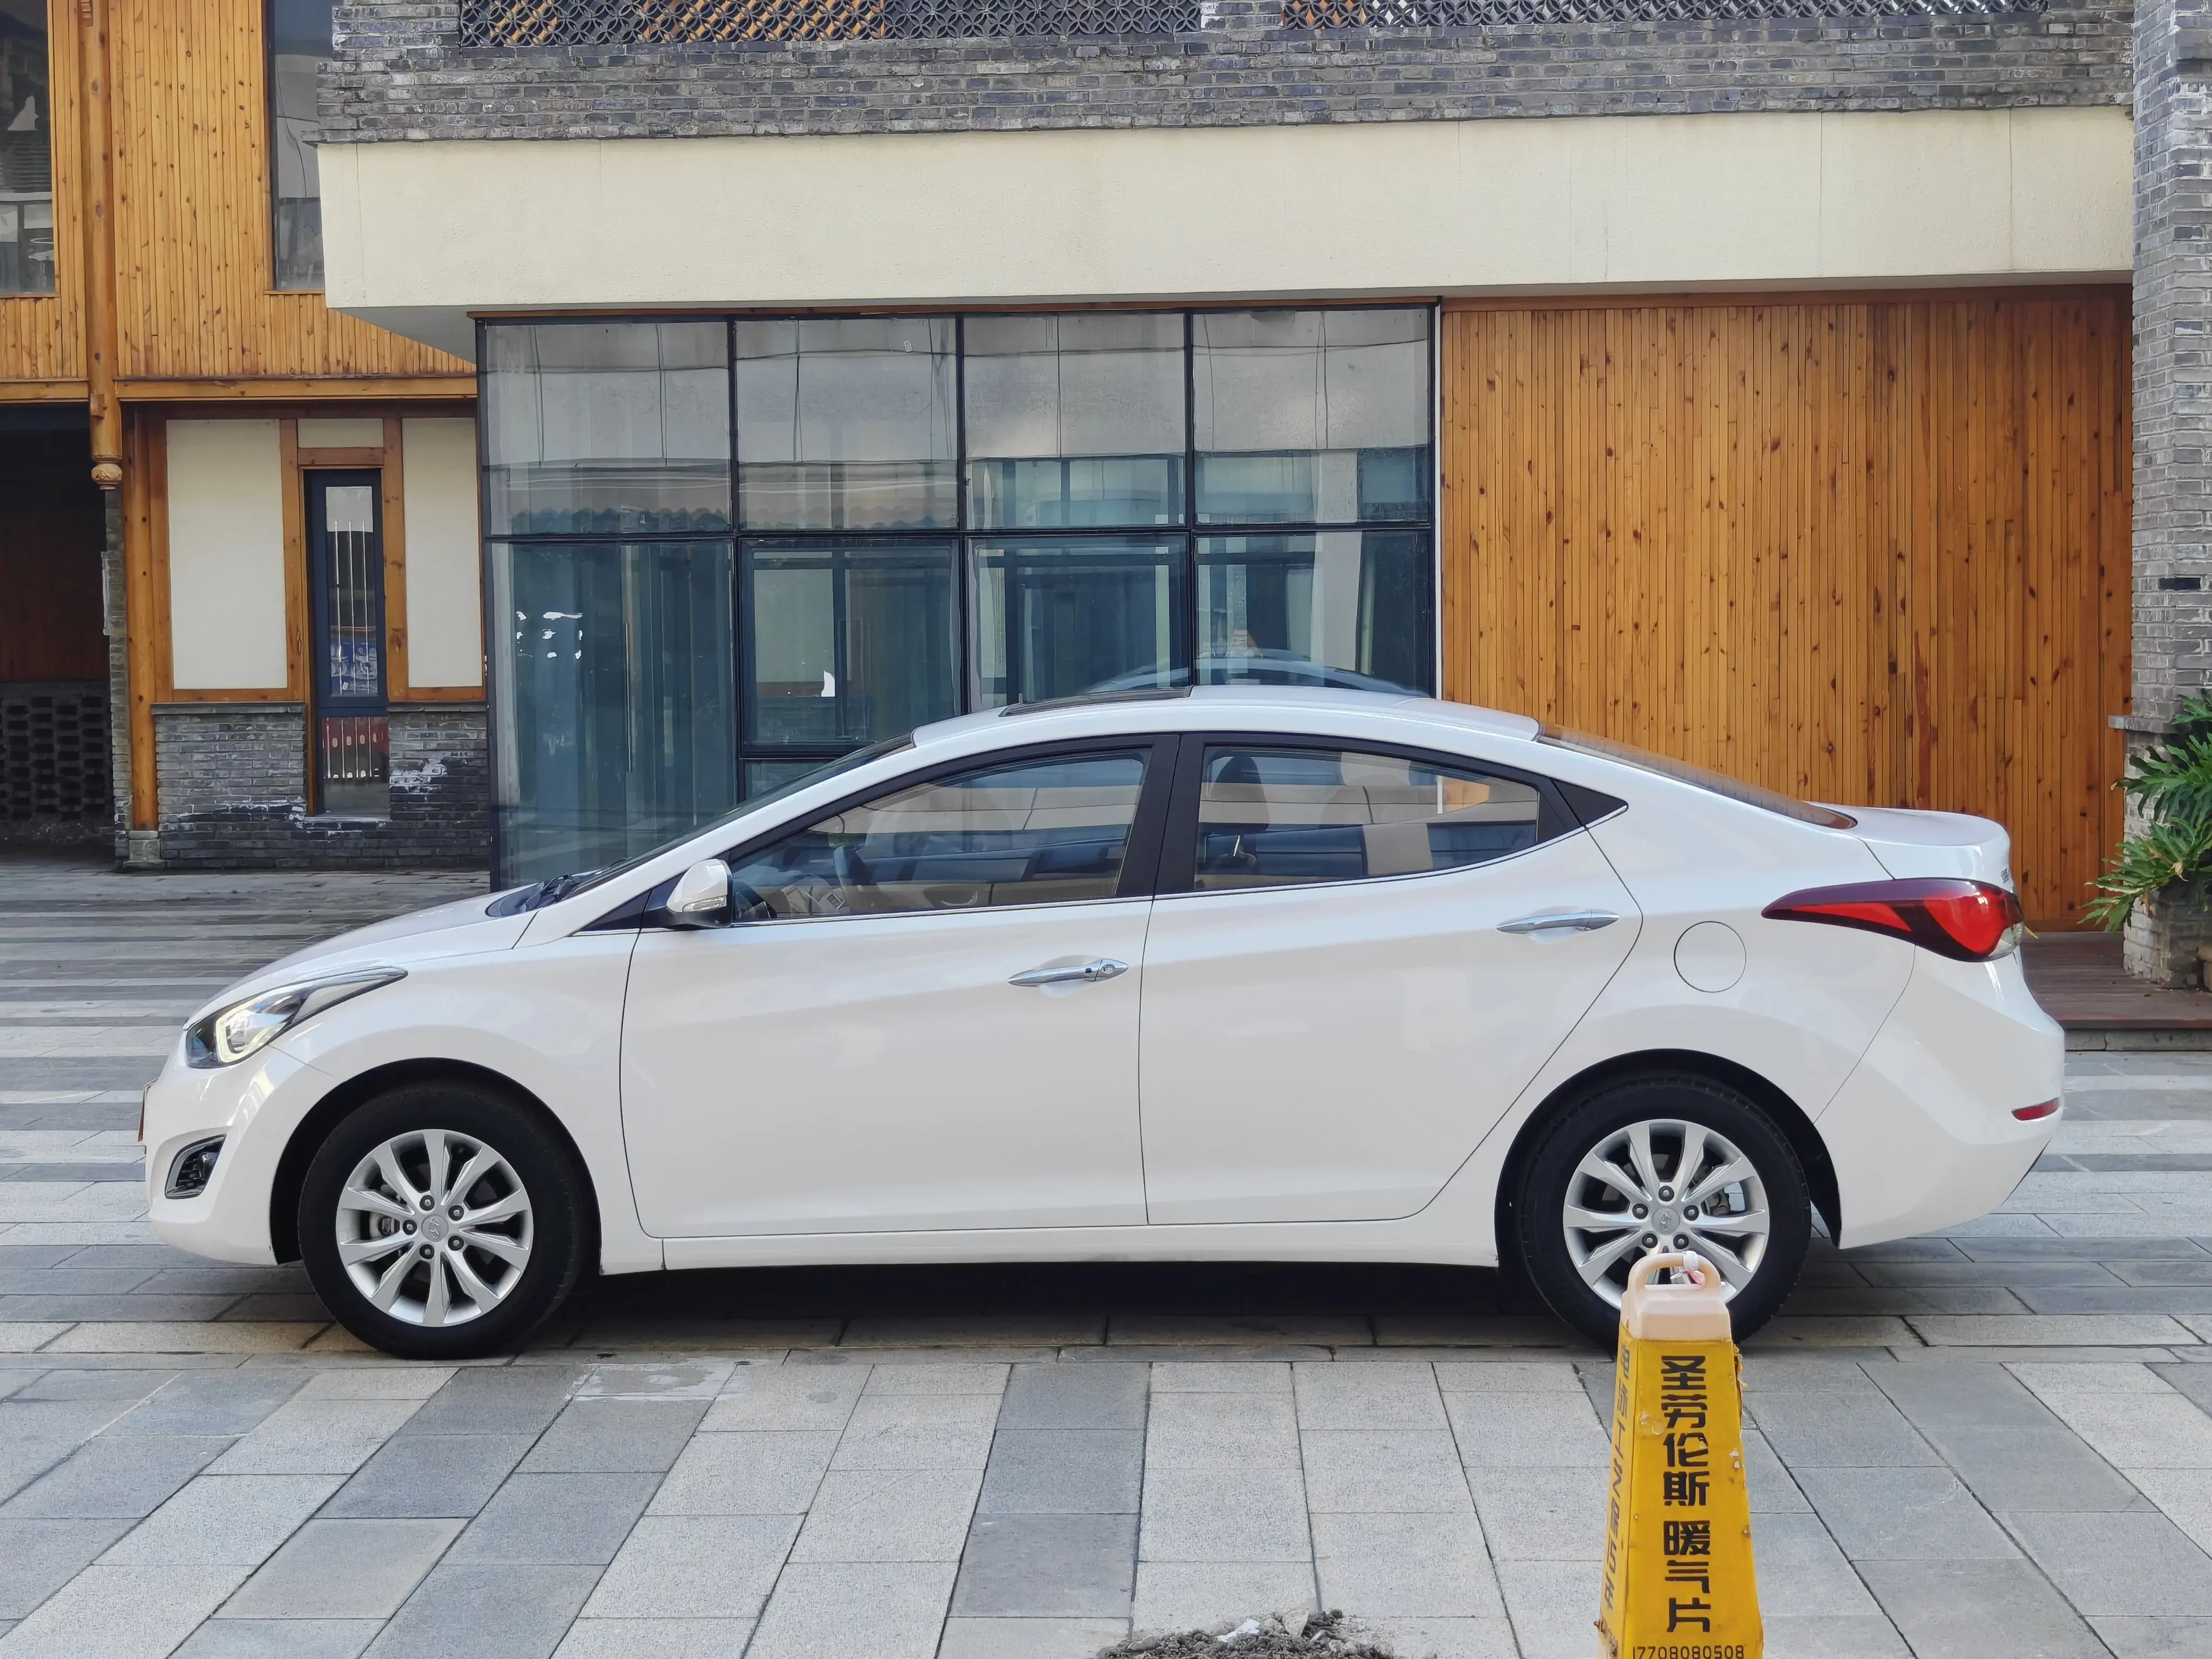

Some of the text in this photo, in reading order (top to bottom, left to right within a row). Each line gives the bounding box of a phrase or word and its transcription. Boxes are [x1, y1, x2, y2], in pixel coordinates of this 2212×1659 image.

[1661, 1355, 1711, 1633] 圣劳伦斯 暖气片
[1633, 1645, 1744, 1659] 17708080508
